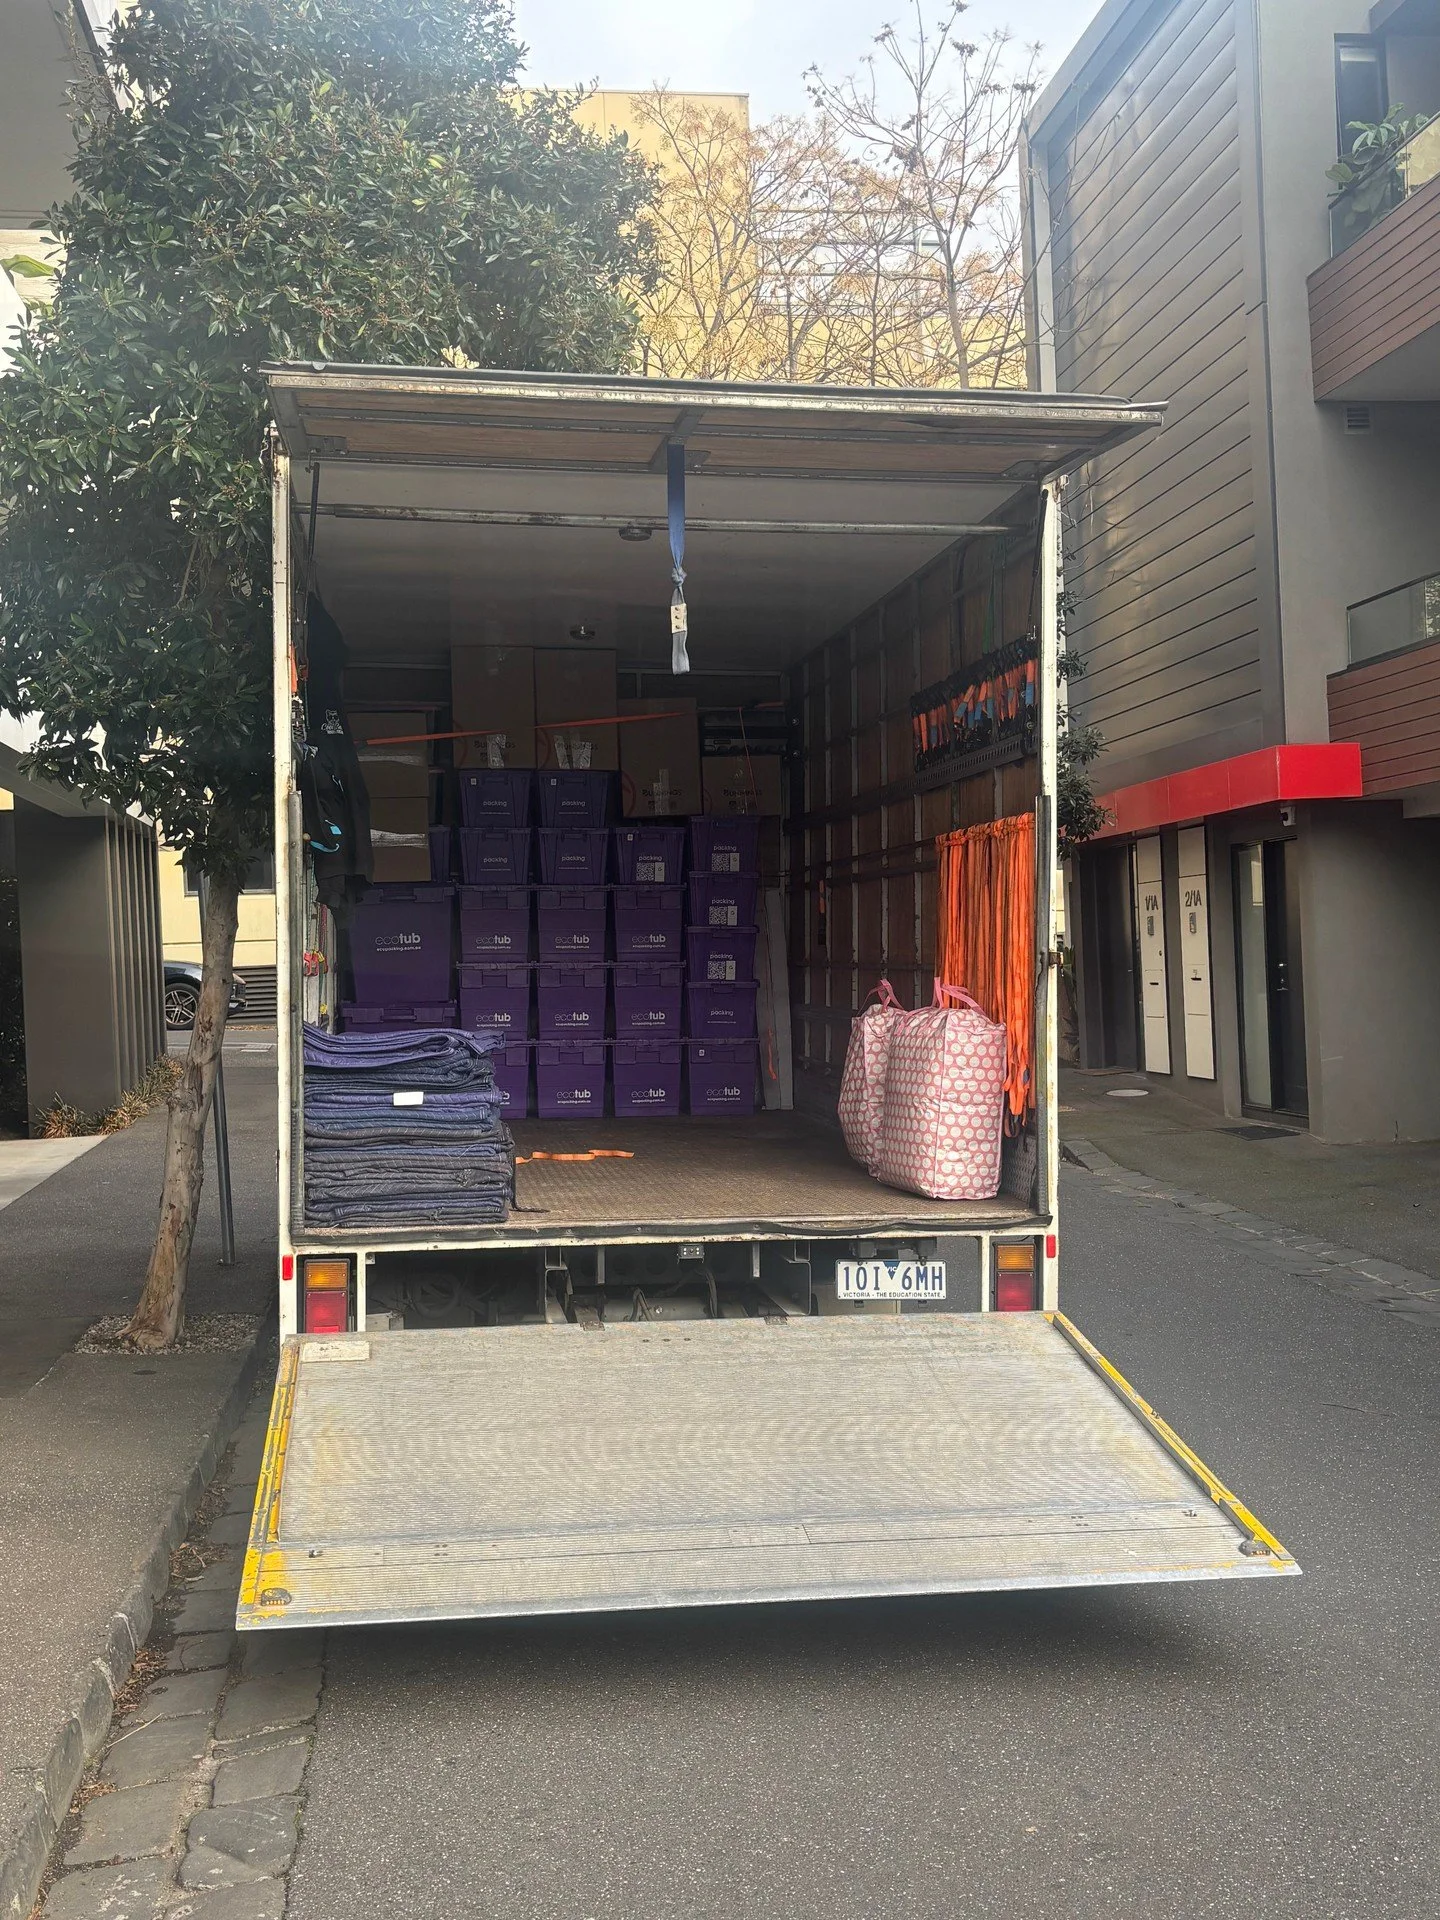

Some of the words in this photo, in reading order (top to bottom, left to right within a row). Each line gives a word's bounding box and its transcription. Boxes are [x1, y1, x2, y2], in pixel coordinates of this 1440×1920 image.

[713, 844, 737, 852] packing
[638, 854, 663, 862] packing
[375, 932, 421, 945] ecotub
[475, 935, 512, 945] ecotub
[555, 934, 590, 944] ecotub
[631, 933, 667, 943] ecotub
[475, 1012, 512, 1022] ecotub
[554, 1011, 590, 1021] ecotub
[631, 1010, 666, 1021] ecotub
[710, 1009, 734, 1017] packing
[556, 1088, 592, 1099] ecotub
[631, 1087, 666, 1098] ecotub
[706, 1086, 741, 1096] ecotub
[901, 1266, 943, 1291] 6MH
